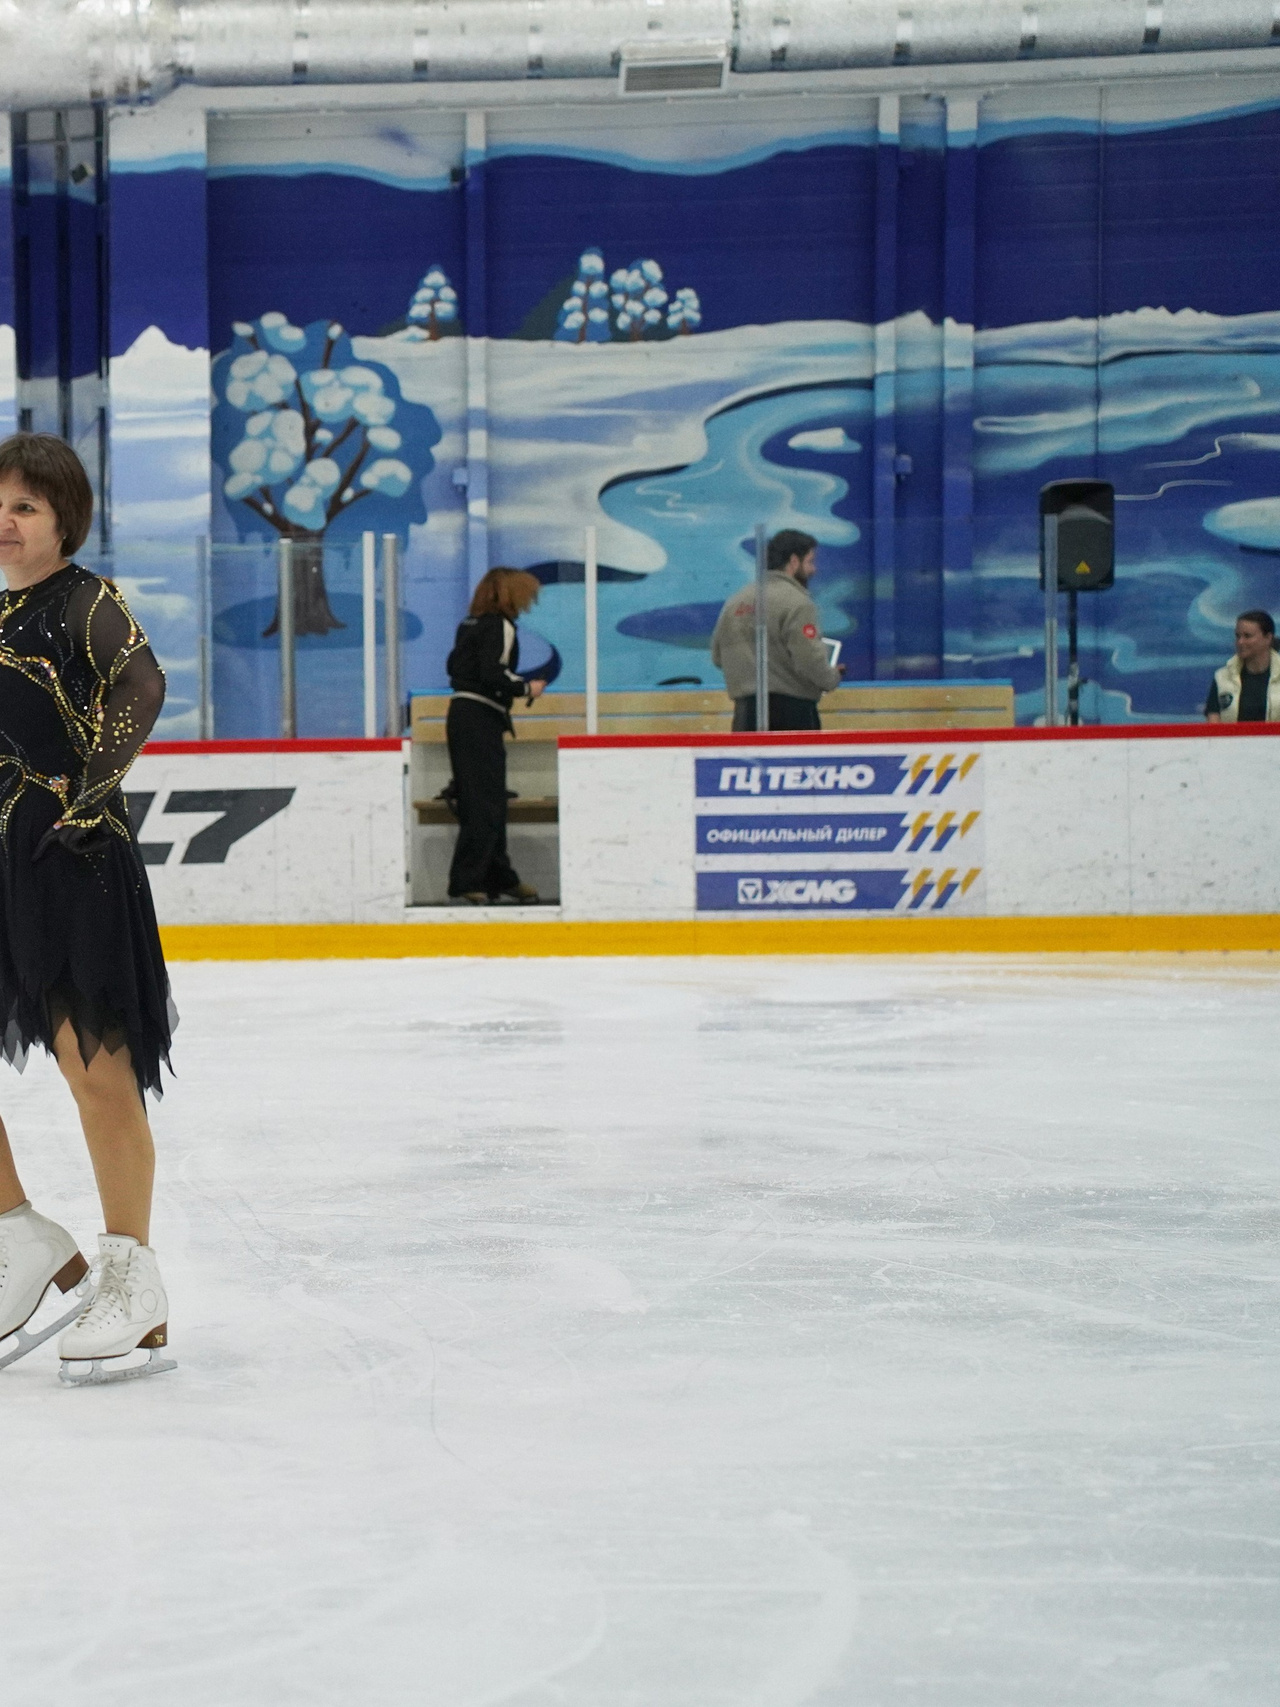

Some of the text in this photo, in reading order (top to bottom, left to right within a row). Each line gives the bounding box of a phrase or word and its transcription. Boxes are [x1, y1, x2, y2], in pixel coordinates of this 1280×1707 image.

[720, 764, 875, 794] ГЦ ТЕХНО
[707, 825, 887, 844] ОФИЦИАЛЬНЫЙ ДИЛЕР
[766, 879, 857, 904] XCMG
